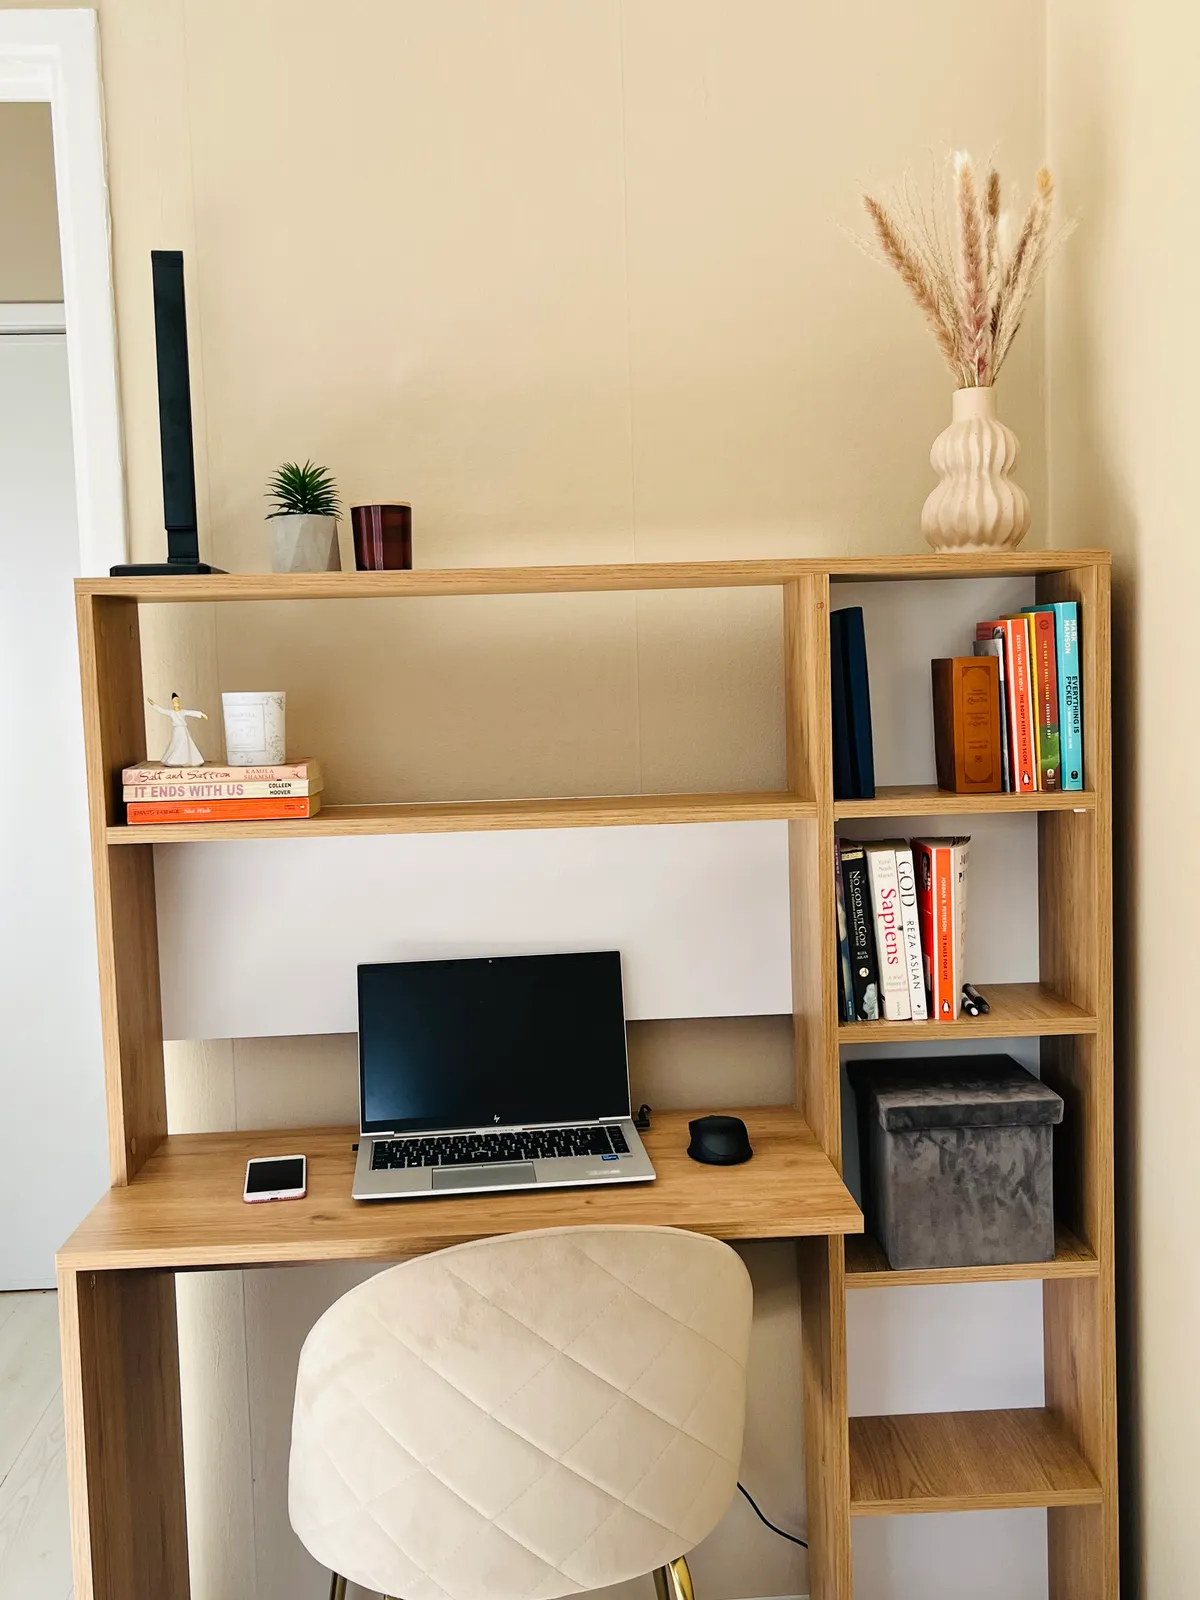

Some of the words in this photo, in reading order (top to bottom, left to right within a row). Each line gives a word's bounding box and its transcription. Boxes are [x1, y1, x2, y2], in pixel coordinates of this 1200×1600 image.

[1063, 620, 1071, 654] MANSON
[1072, 676, 1080, 724] EVERYTHING
[1073, 726, 1080, 734] IS
[134, 786, 147, 798] IT
[151, 785, 185, 798] ENDS
[189, 784, 222, 797] WITH
[226, 784, 245, 796] US
[139, 771, 165, 782] Salt
[166, 771, 184, 780] and
[898, 861, 916, 907] GOD
[877, 888, 899, 965] Sapiens
[906, 920, 916, 948] REZA
[910, 953, 921, 990] ASLAN
